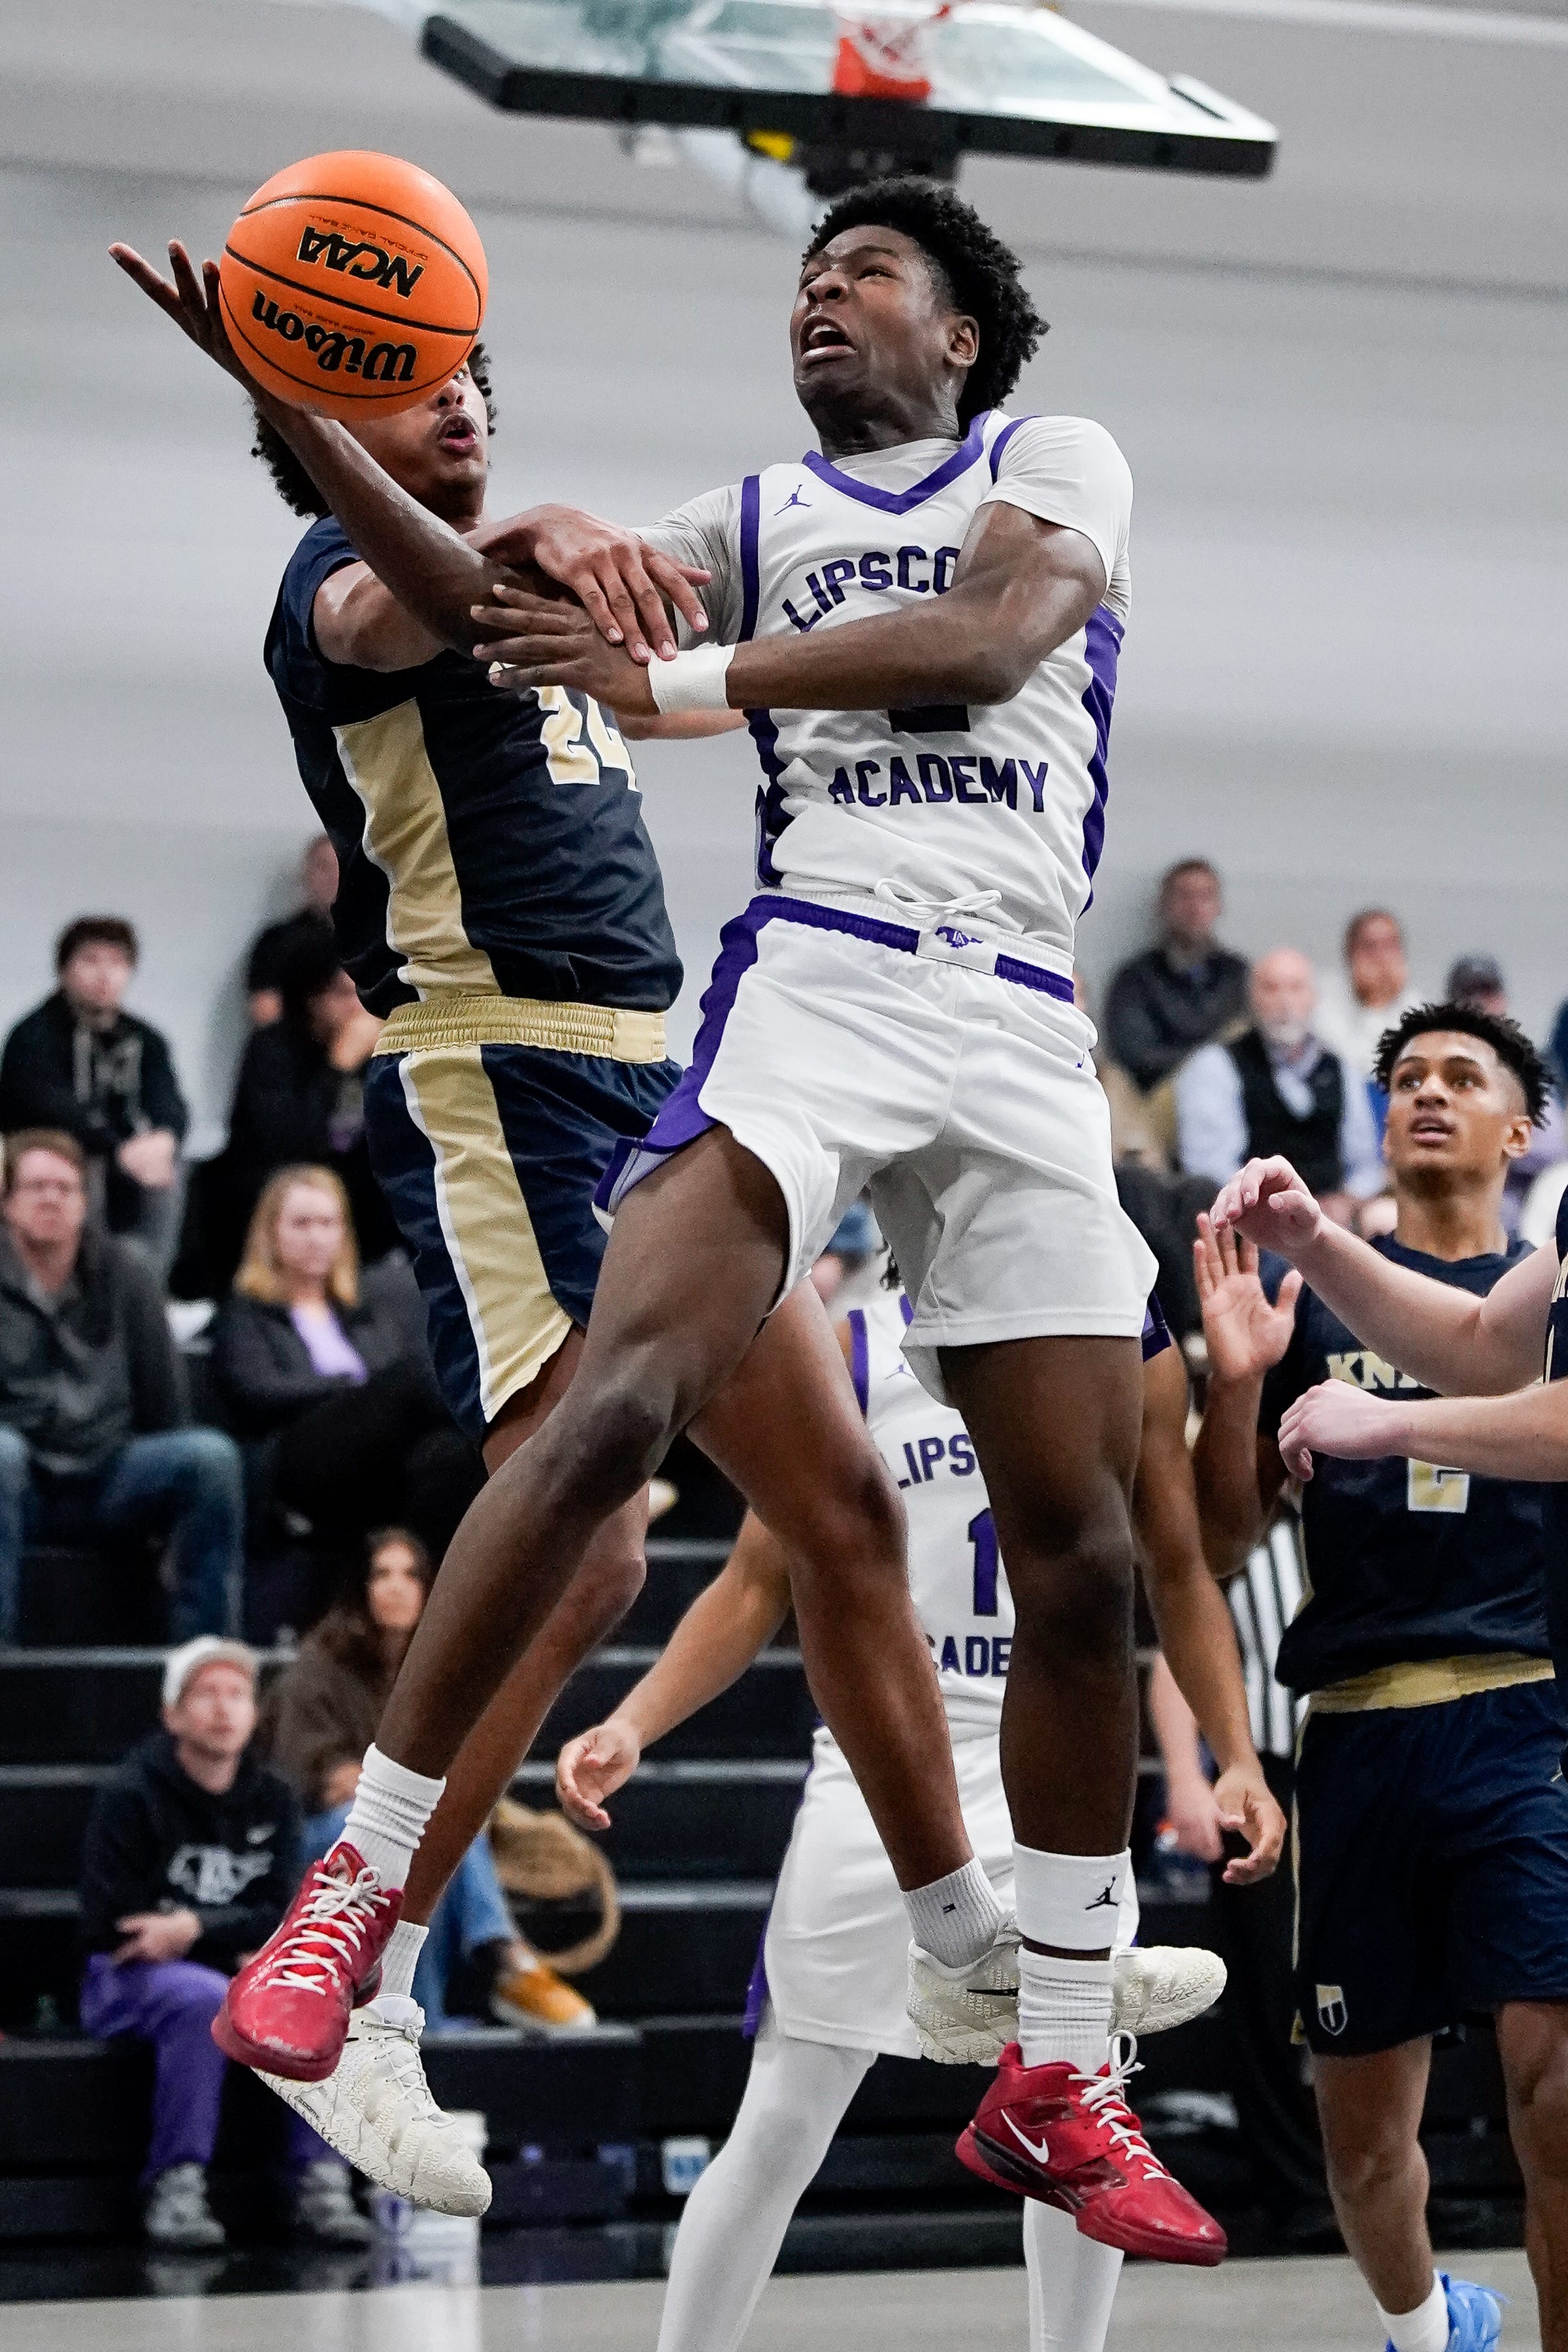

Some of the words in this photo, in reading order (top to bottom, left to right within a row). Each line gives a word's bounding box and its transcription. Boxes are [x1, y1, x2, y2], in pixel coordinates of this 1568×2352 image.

[296, 225, 425, 300] NCAA
[252, 288, 417, 382] Wilson
[828, 753, 1049, 813] ACADEMY
